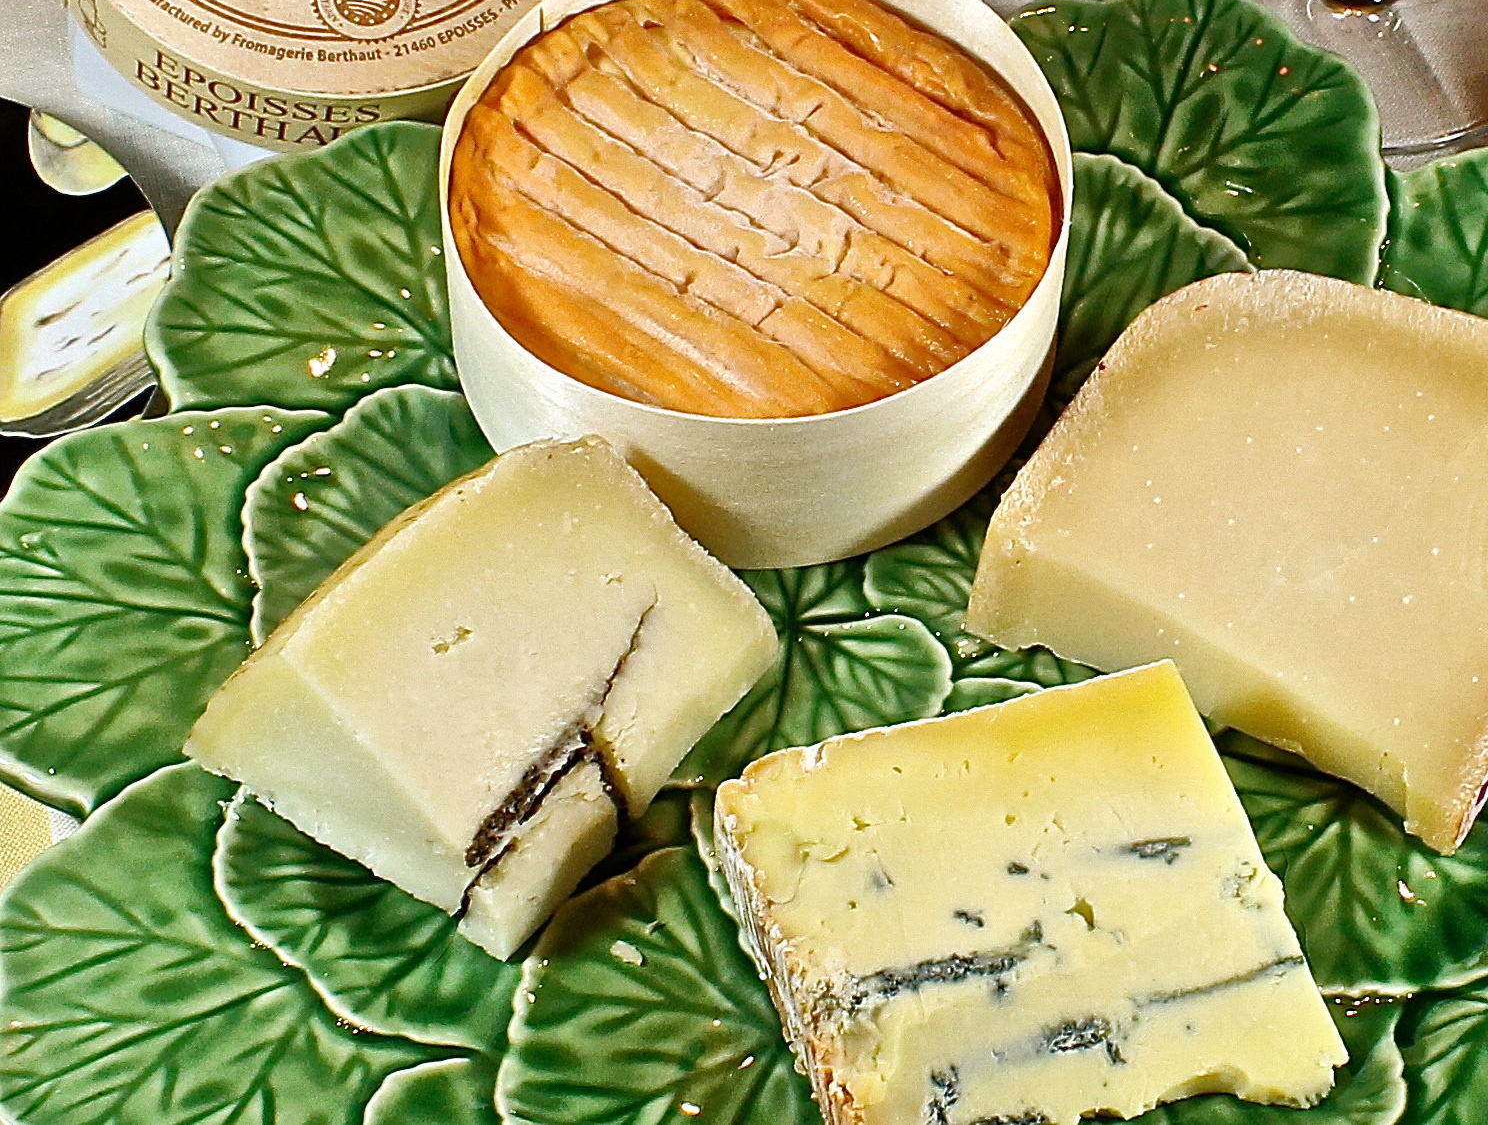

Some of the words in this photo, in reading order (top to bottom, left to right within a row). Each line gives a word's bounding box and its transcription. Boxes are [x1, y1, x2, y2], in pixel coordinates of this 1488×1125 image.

[212, 26, 230, 44] by
[231, 33, 314, 62] Fromagerie
[317, 49, 381, 63] Berthaut
[394, 36, 436, 57] 21460
[438, 8, 498, 45] EPOISSES
[155, 50, 381, 123] EPOISSES
